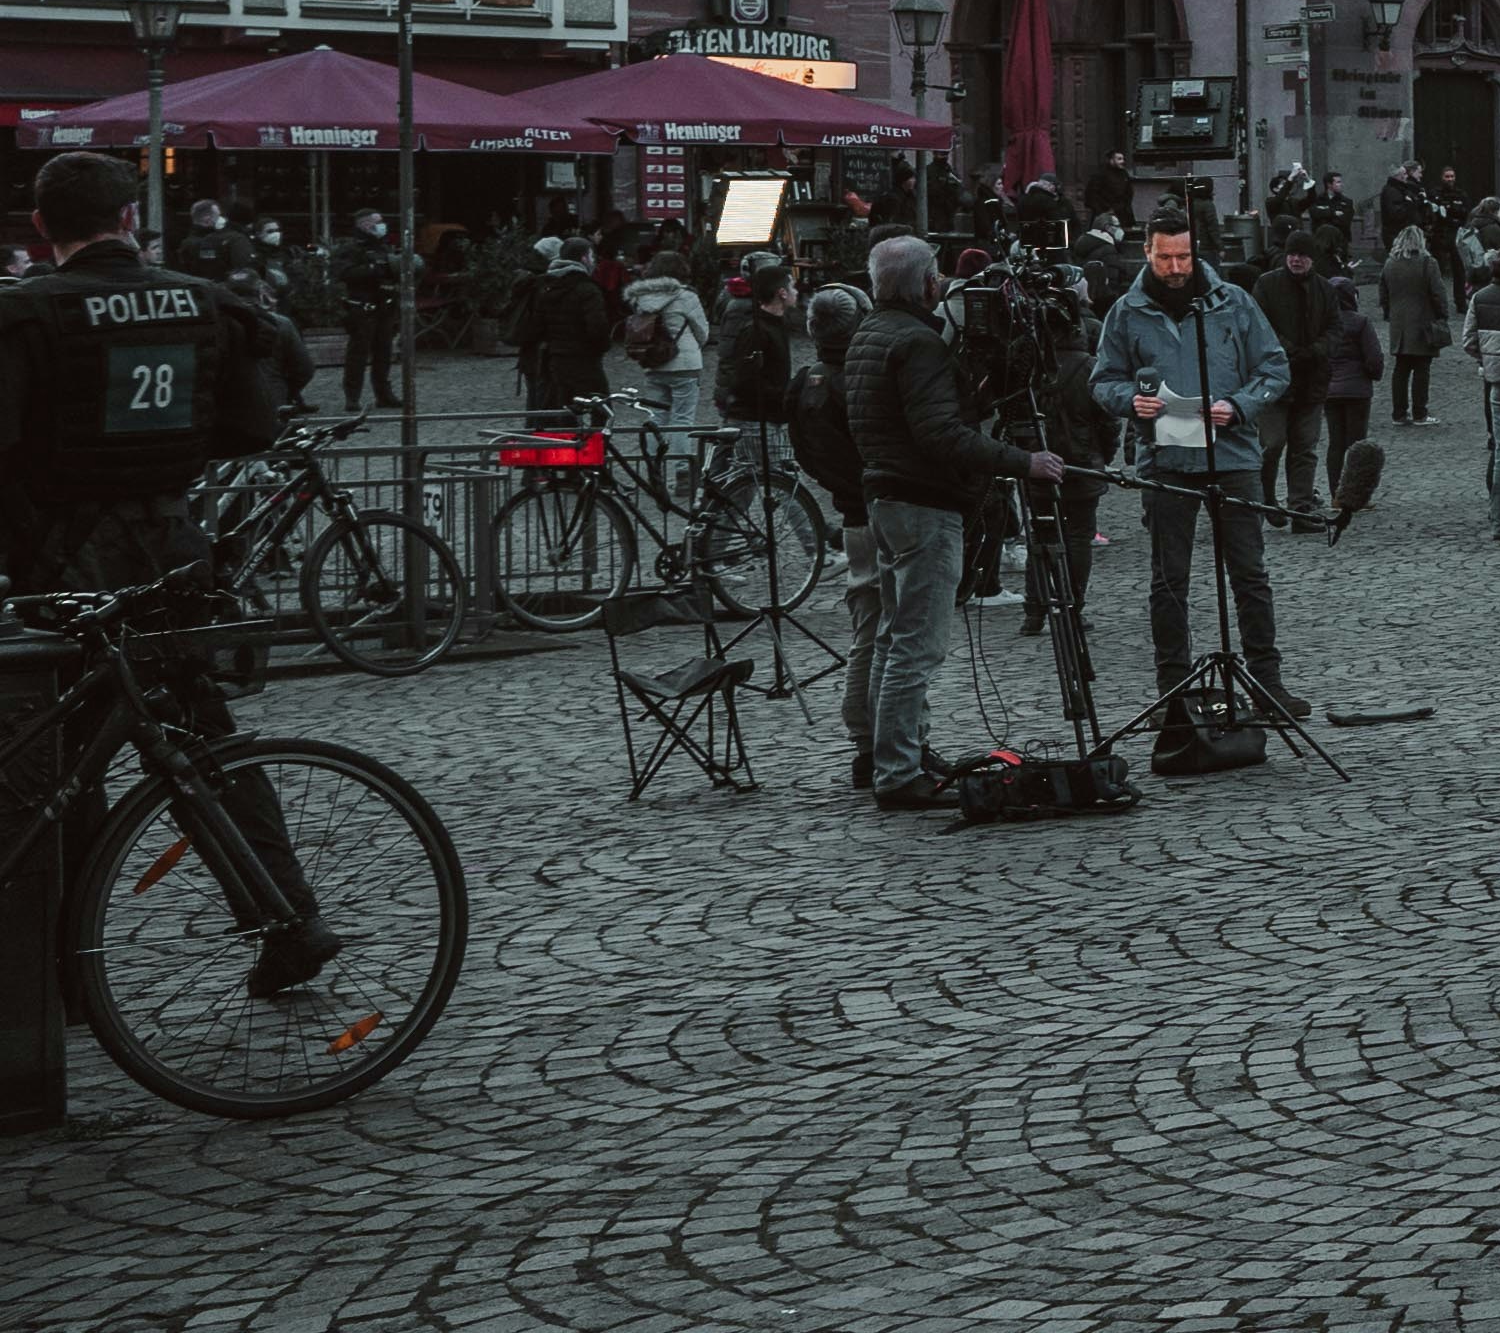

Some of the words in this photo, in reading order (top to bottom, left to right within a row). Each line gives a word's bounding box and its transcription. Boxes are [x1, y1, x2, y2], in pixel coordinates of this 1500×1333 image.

[737, 27, 832, 61] LIMPURG
[290, 125, 378, 149] Henninger
[524, 127, 572, 141] ALTEN
[664, 122, 742, 143] Henninger
[821, 133, 878, 146] LIMPURG
[870, 124, 912, 138] ALTEN
[469, 137, 534, 150] LIMPURG
[84, 289, 200, 326] POLIZEI
[129, 364, 174, 410] 28
[1140, 380, 1152, 390] hr
